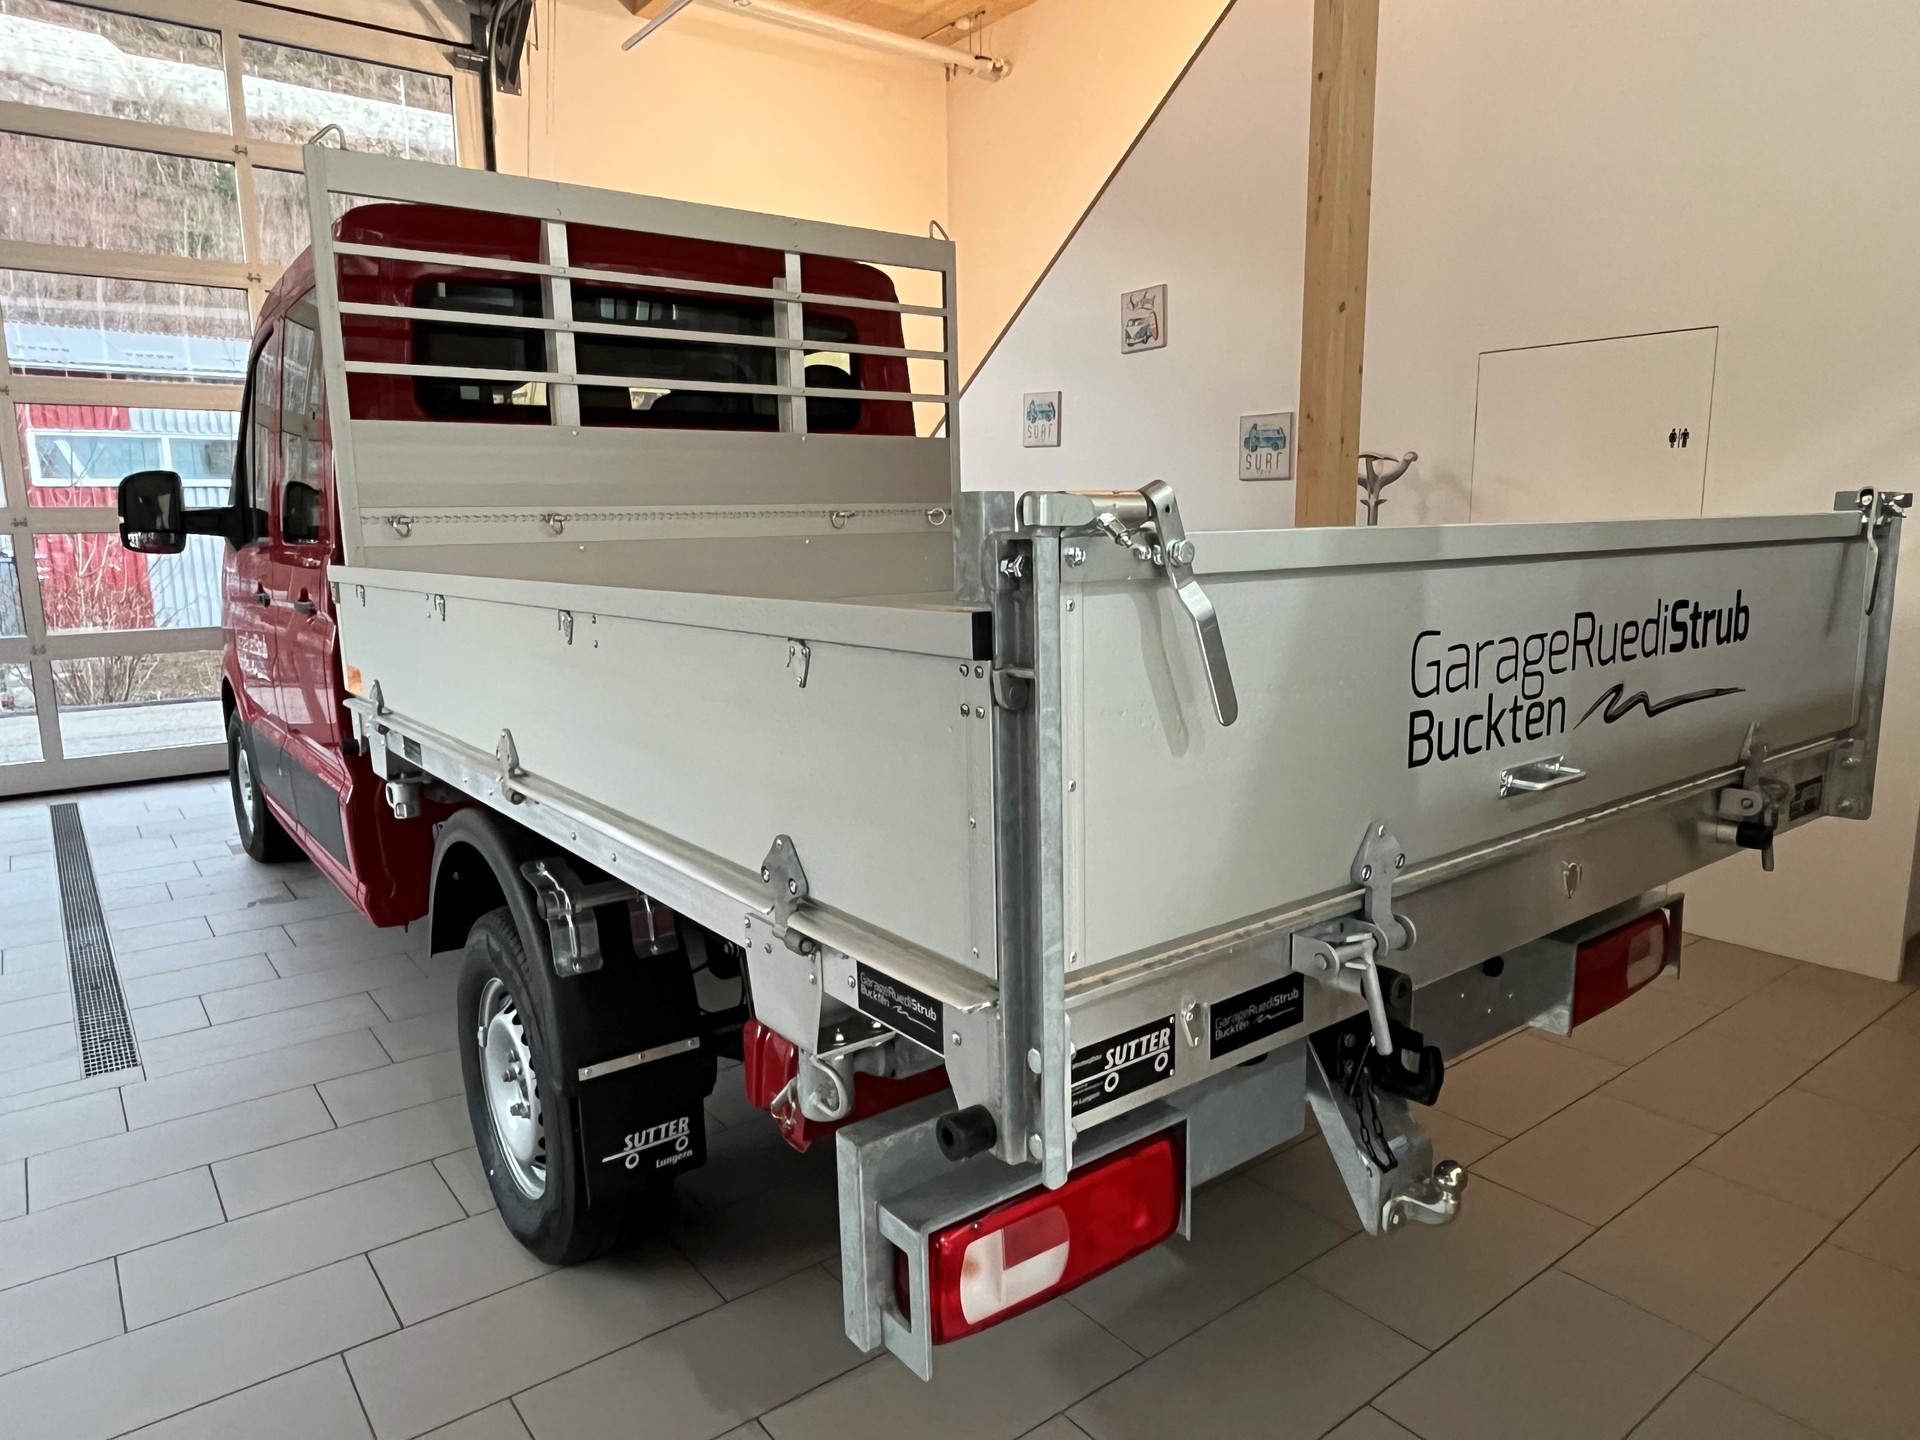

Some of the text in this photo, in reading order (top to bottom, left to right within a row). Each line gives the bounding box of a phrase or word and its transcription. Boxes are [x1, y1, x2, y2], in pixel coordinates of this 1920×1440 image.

[1245, 451, 1283, 470] SURF
[1411, 589, 1750, 701] GarageRuediStrub
[1408, 692, 1567, 769] Buckten
[1104, 1027, 1171, 1070] SUTTER
[623, 1116, 690, 1152] SUTTER
[655, 1149, 693, 1169] Lungern
